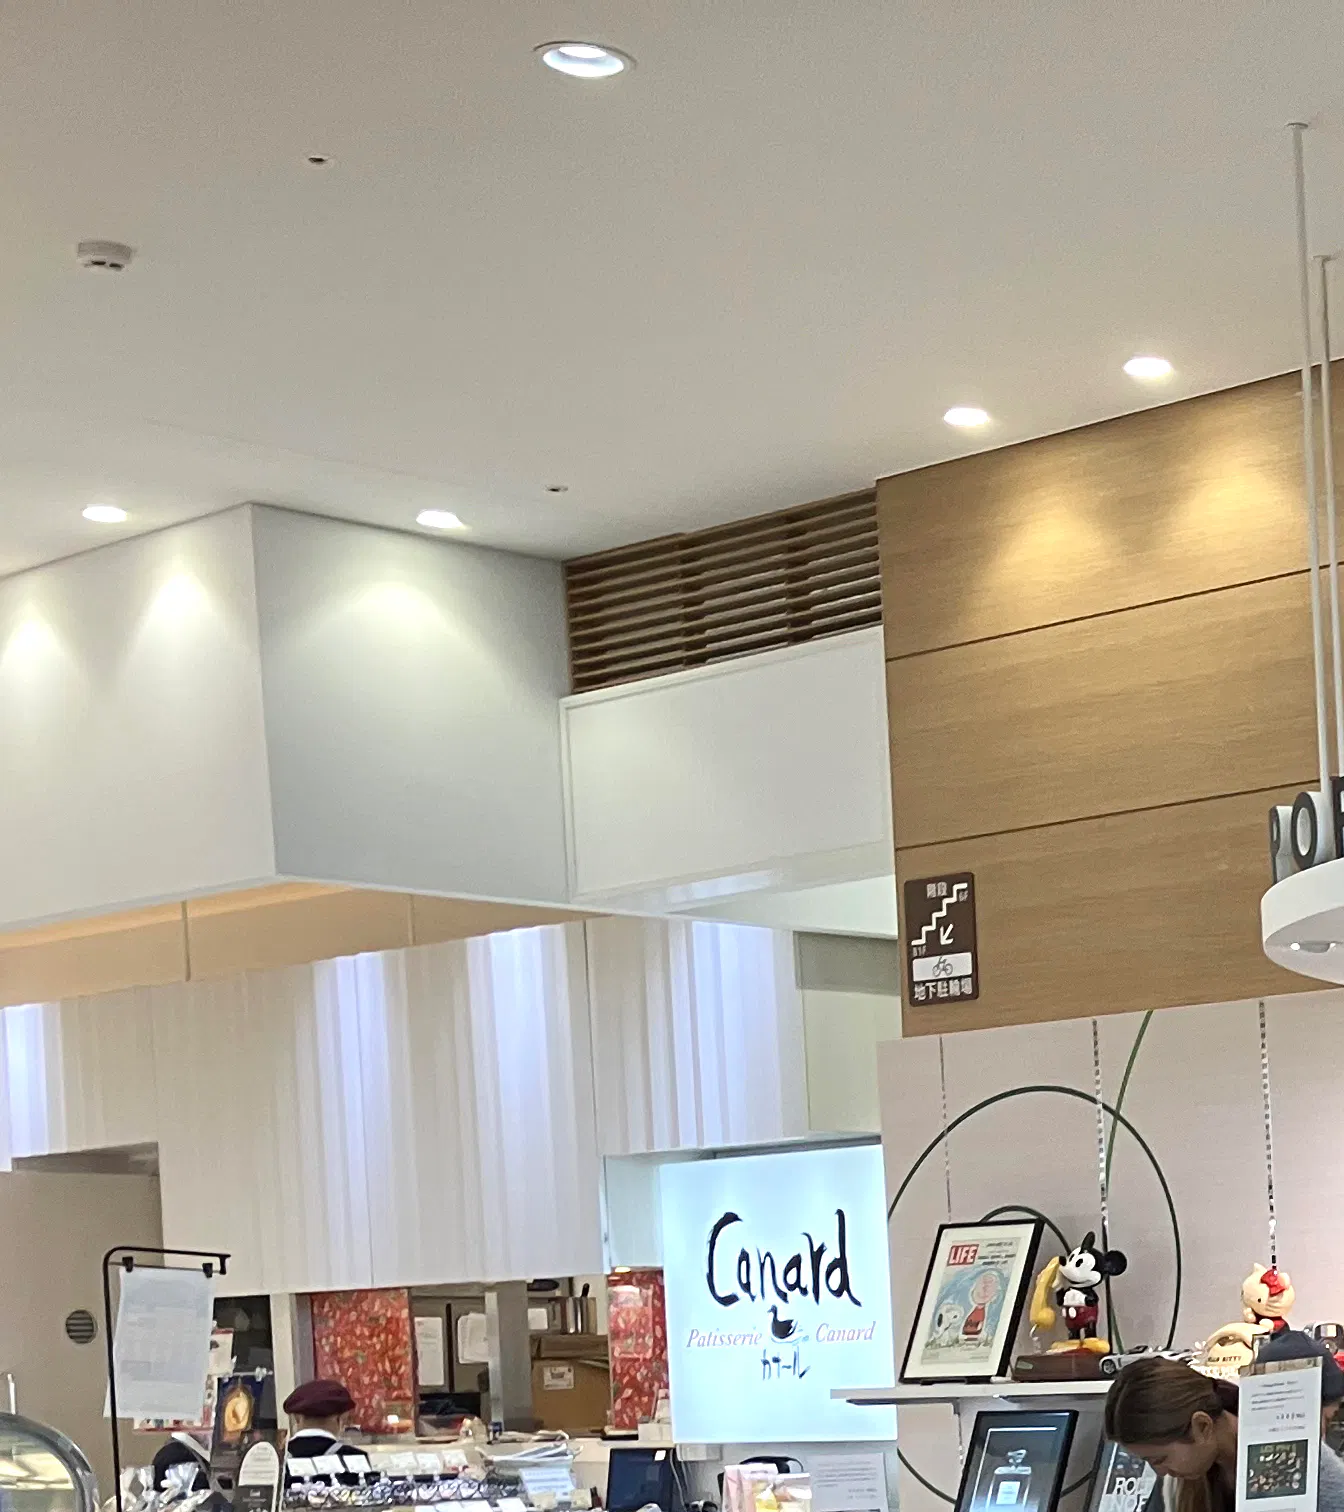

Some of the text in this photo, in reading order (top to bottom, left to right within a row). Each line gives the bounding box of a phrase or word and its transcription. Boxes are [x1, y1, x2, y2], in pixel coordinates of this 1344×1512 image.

[706, 1209, 862, 1307] Canard
[948, 1245, 978, 1265] LIFE
[686, 1320, 876, 1349] Patisserie Canard
